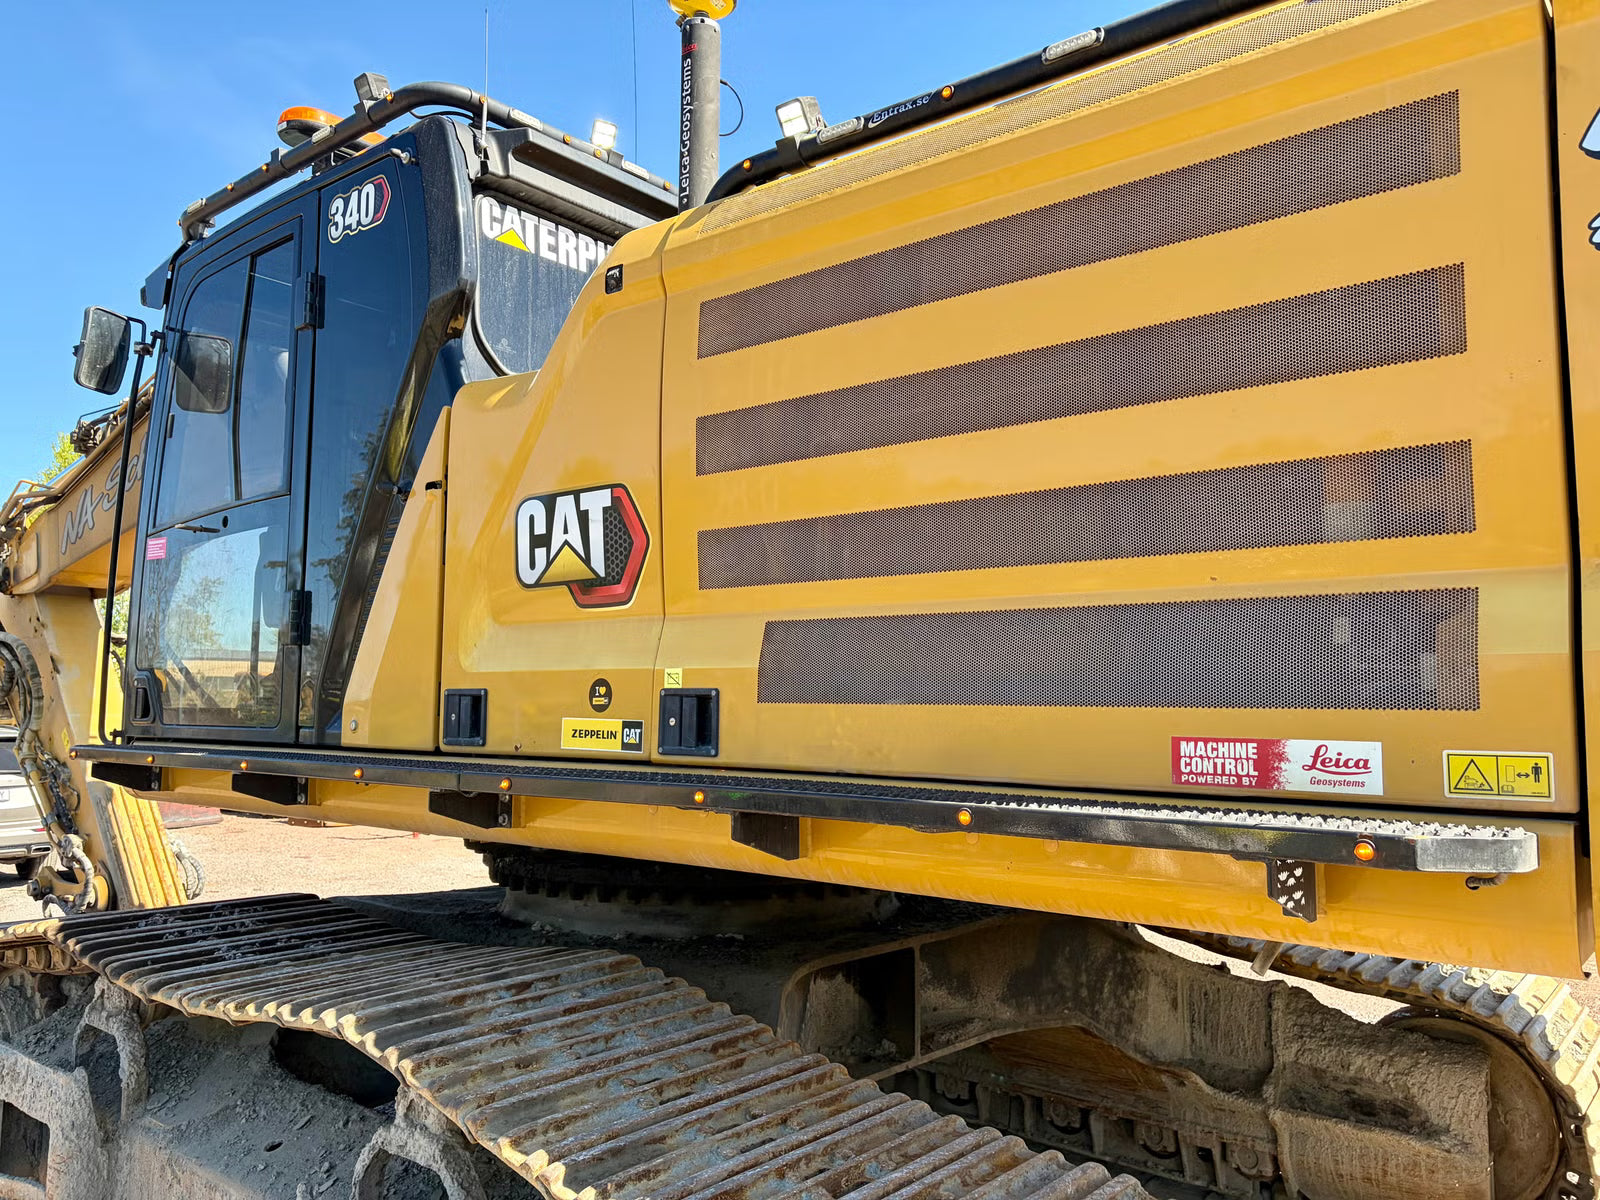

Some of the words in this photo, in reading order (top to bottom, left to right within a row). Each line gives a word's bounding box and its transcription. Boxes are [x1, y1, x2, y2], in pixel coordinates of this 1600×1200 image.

[680, 58, 693, 152] Geosystems
[872, 95, 929, 122] Entrax.se
[680, 156, 690, 197] Leica
[330, 183, 375, 239] 340
[481, 196, 613, 273] CATERPI
[517, 488, 612, 585] CAT
[571, 728, 618, 740] ZEPPELIN
[623, 727, 642, 743] CAT
[1180, 740, 1258, 759] MACHINE
[1180, 757, 1259, 776] CONTROL
[1302, 744, 1372, 775] Leica
[1181, 774, 1238, 785] POWERED
[1242, 776, 1257, 786] BY
[1309, 776, 1366, 788] Geosystems
